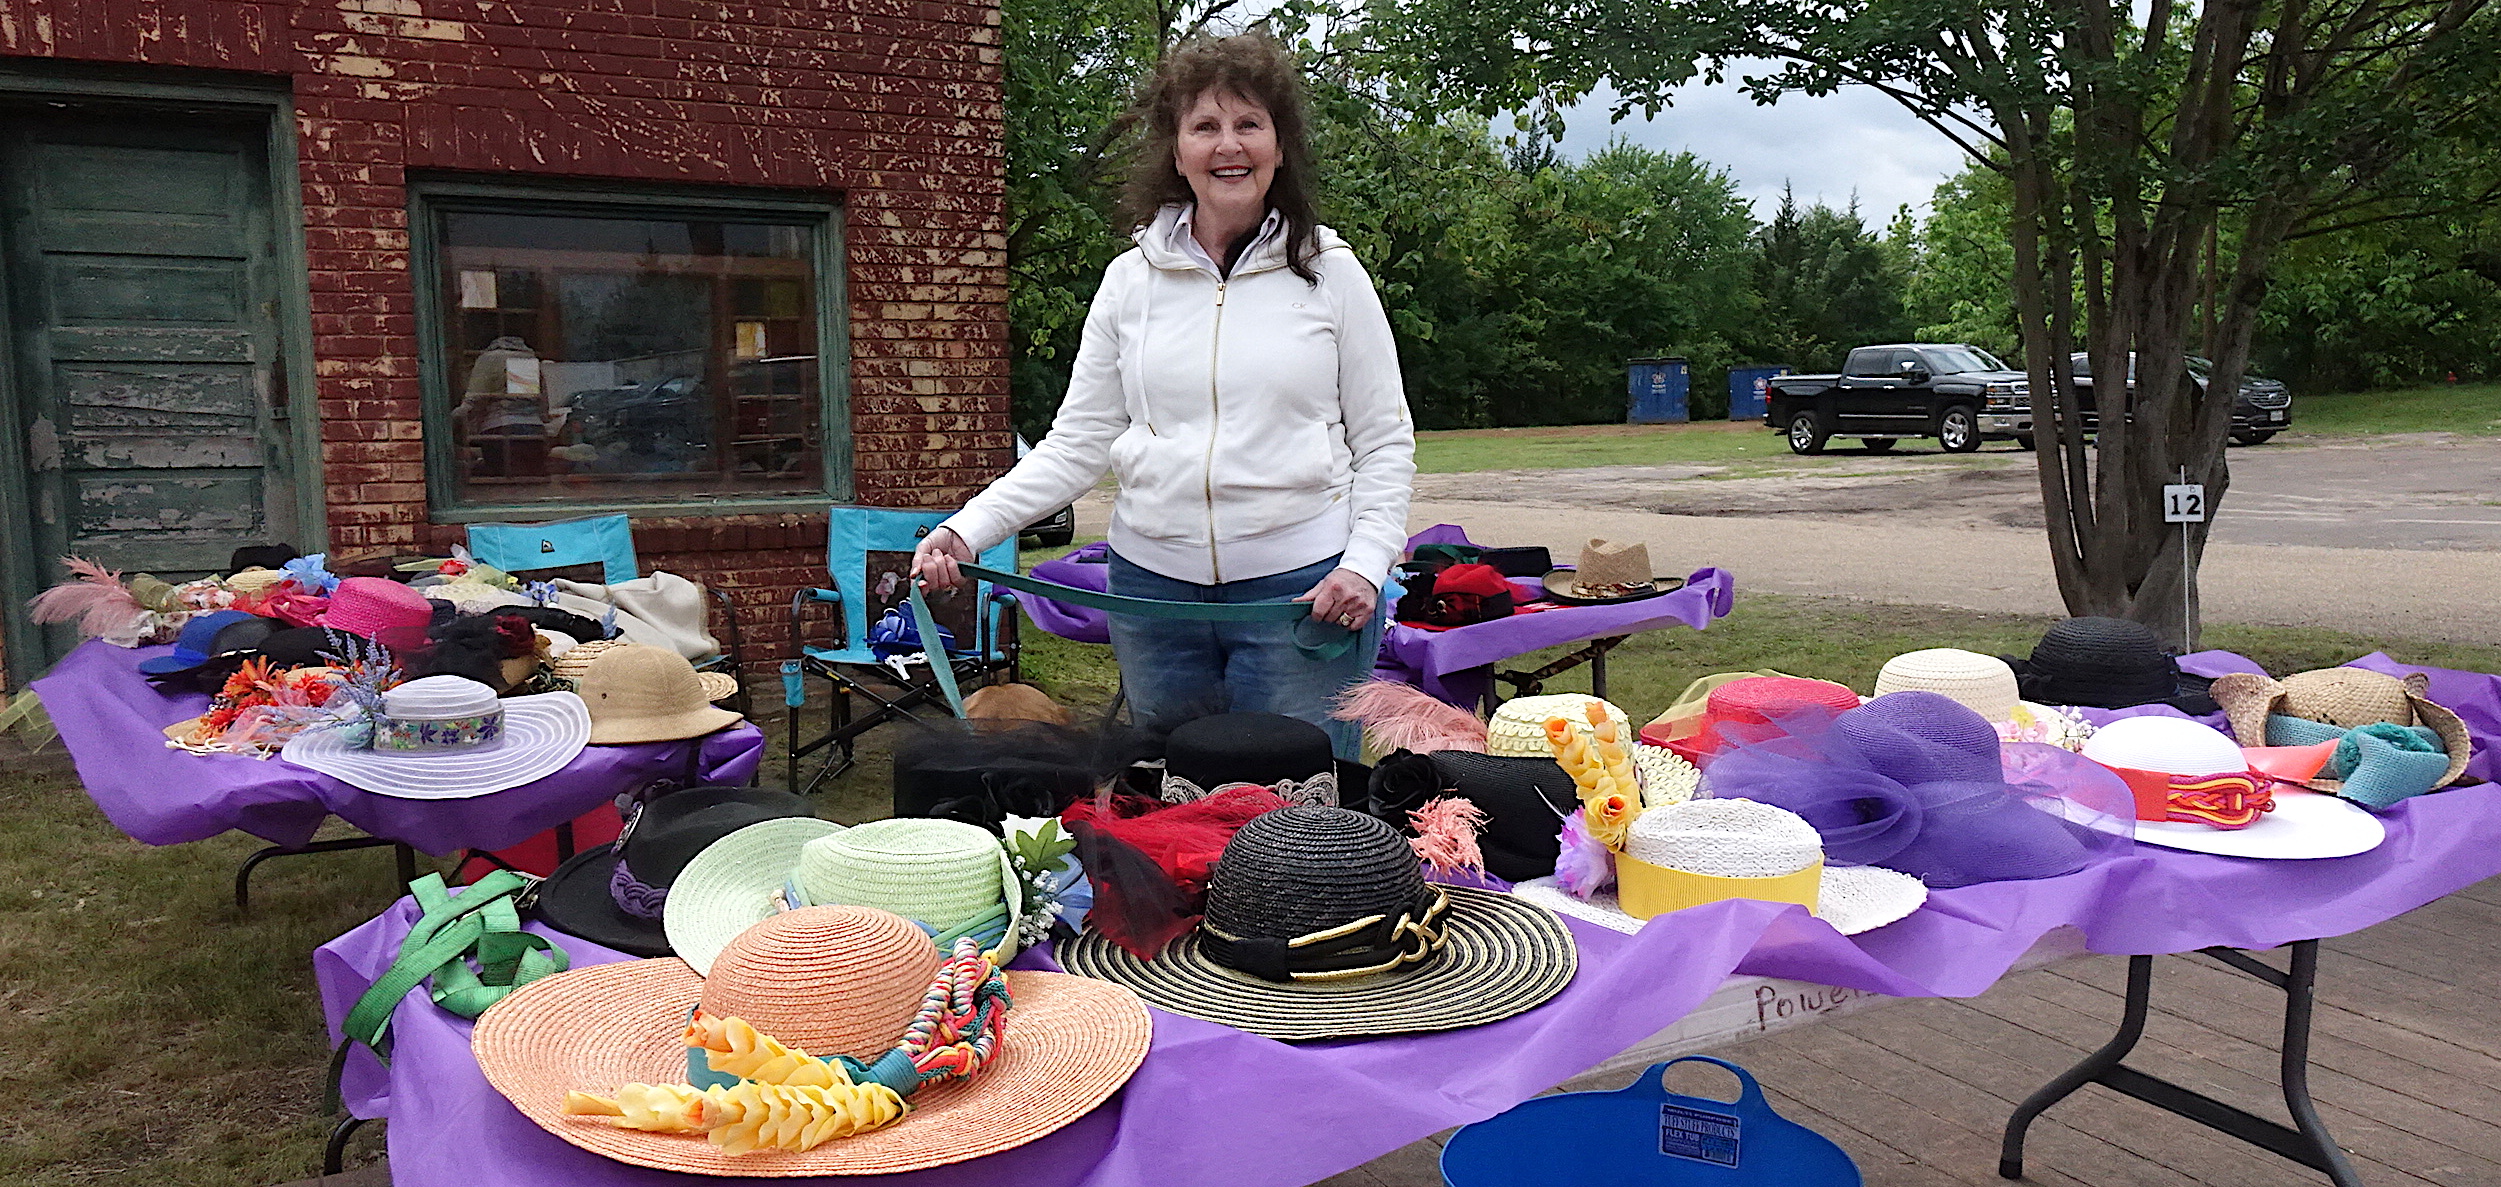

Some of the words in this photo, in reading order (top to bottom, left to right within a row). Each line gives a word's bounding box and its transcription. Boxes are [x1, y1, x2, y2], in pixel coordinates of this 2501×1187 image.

[2170, 493, 2201, 516] 12
[1754, 985, 1880, 1032] Powe
[1665, 1128, 1684, 1139] FLEX
[1685, 1131, 1700, 1142] TUB
